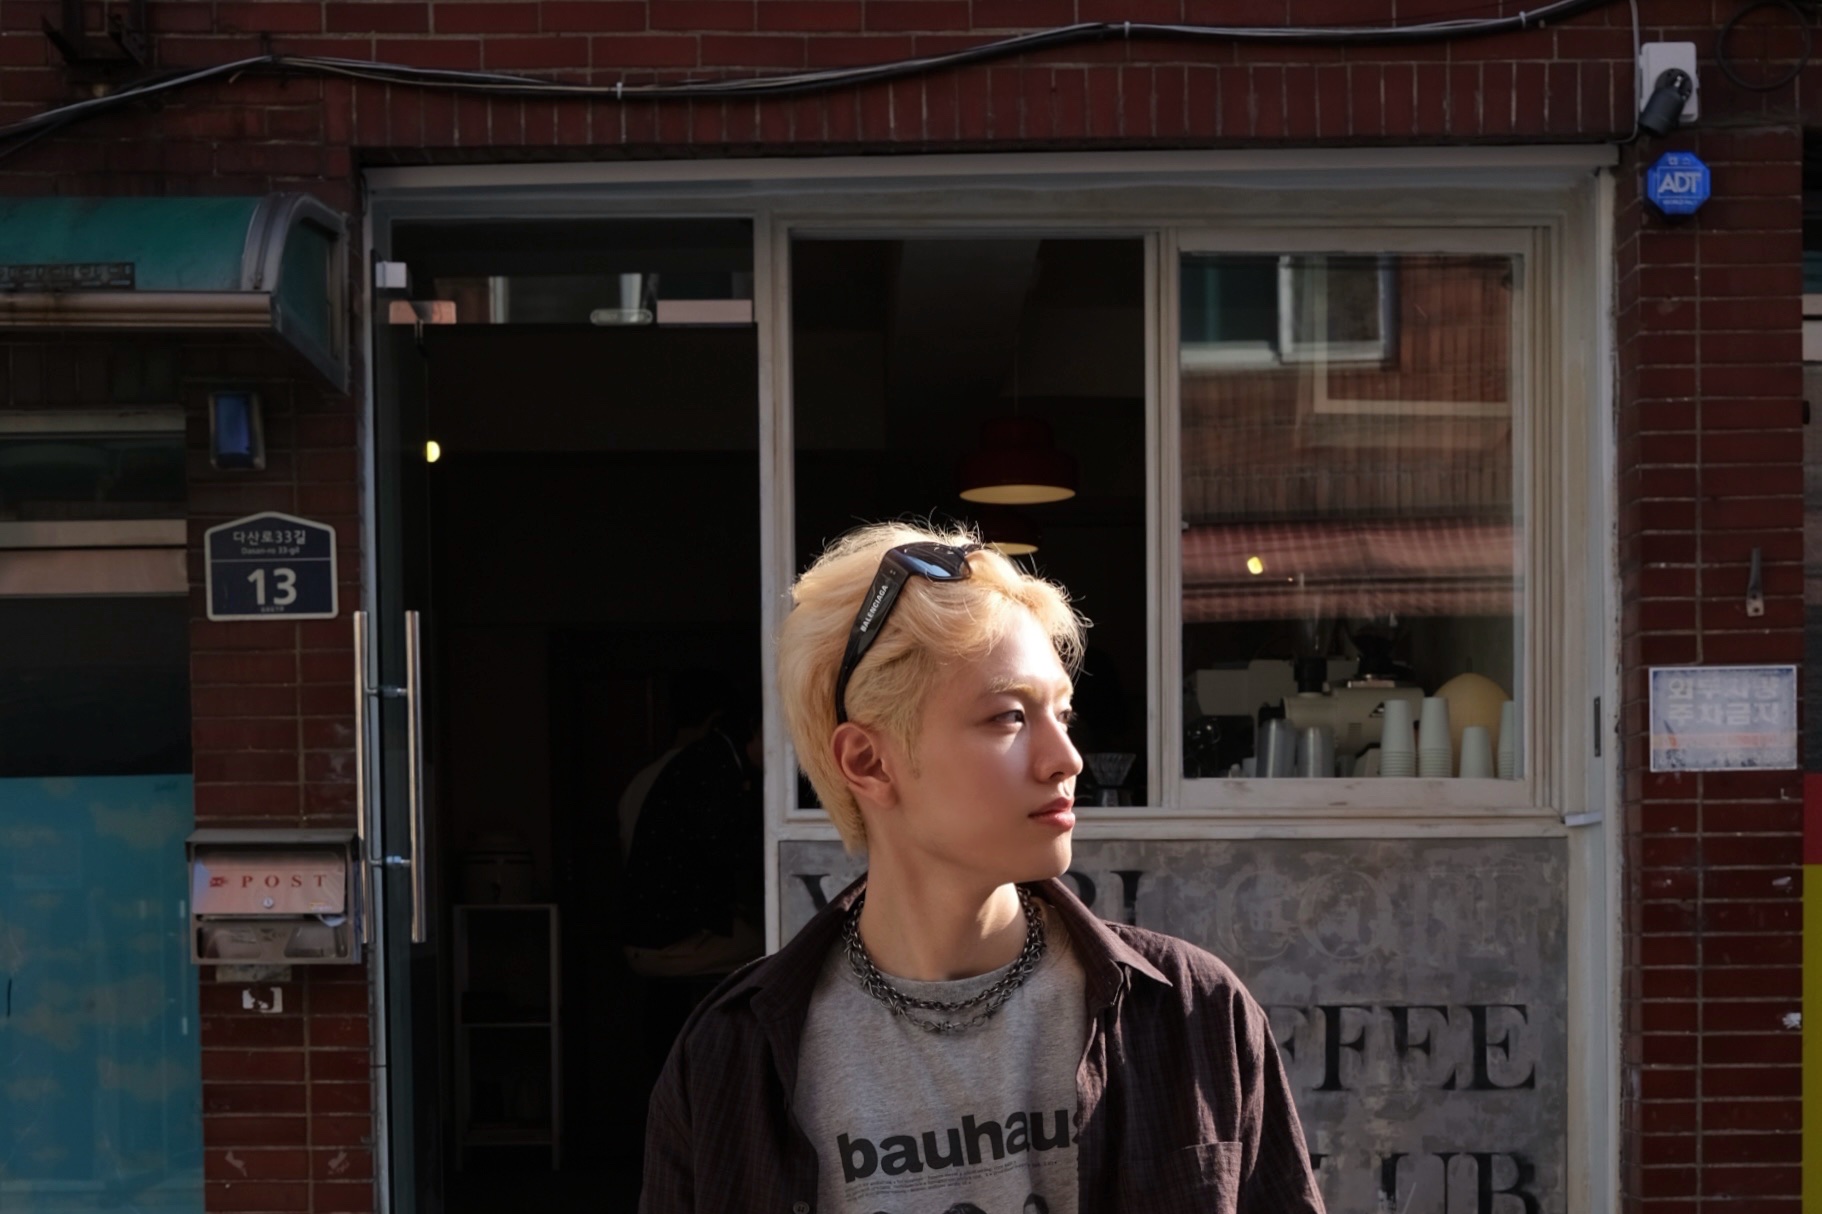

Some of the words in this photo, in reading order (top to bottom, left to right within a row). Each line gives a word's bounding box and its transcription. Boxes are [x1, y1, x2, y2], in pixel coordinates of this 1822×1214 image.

[1657, 171, 1702, 193] ADT
[232, 530, 306, 546] 다산로33길
[246, 567, 298, 606] 13
[859, 584, 889, 633] BALENCIAGA
[1667, 702, 1780, 726] 주차금지
[242, 874, 327, 888] POST
[836, 1109, 1080, 1184] bauhau
